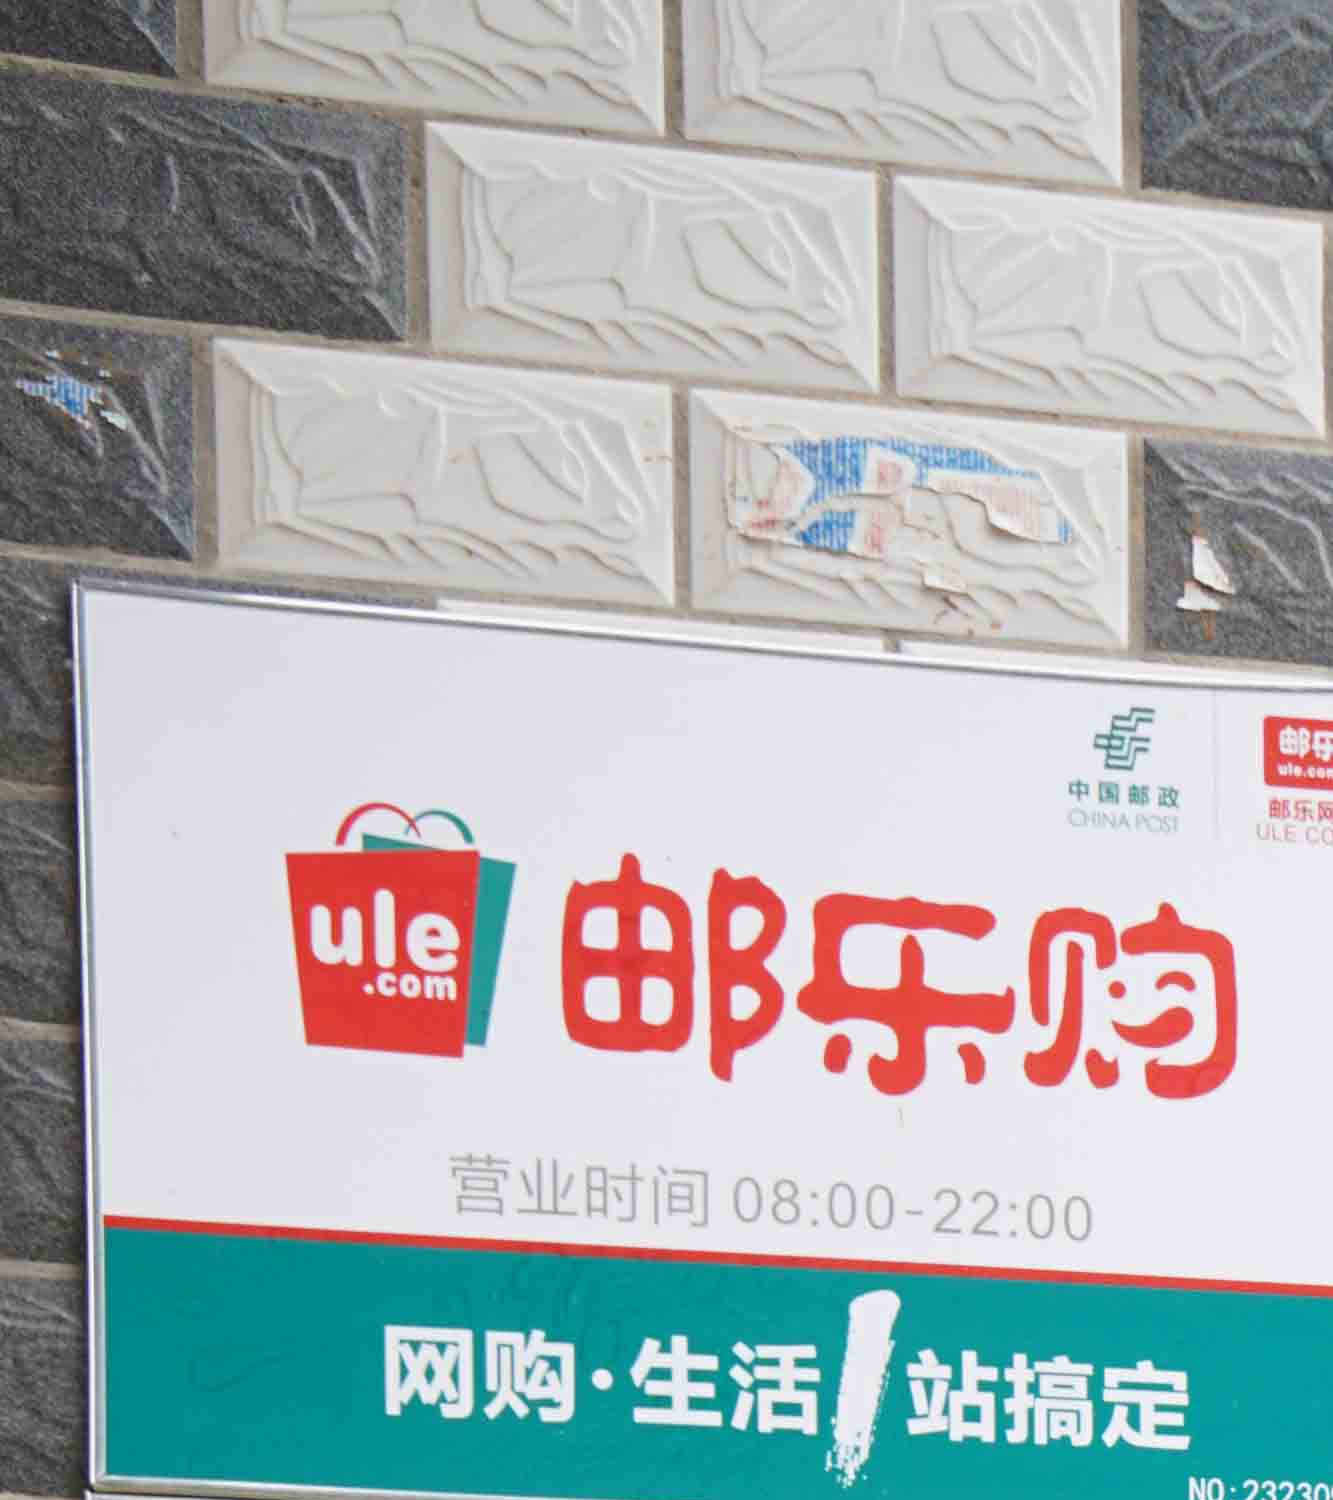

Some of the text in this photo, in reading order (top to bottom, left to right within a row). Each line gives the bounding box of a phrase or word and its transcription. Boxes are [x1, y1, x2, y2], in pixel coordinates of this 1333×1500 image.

[1067, 809, 1179, 835] CHINA POST
[1068, 779, 1180, 809] 中国邮政
[308, 888, 461, 970] ule
[362, 968, 458, 1003] .com
[561, 853, 1238, 1100] 邮乐购
[449, 1153, 1093, 1241] 营业时间 08:00-22:00
